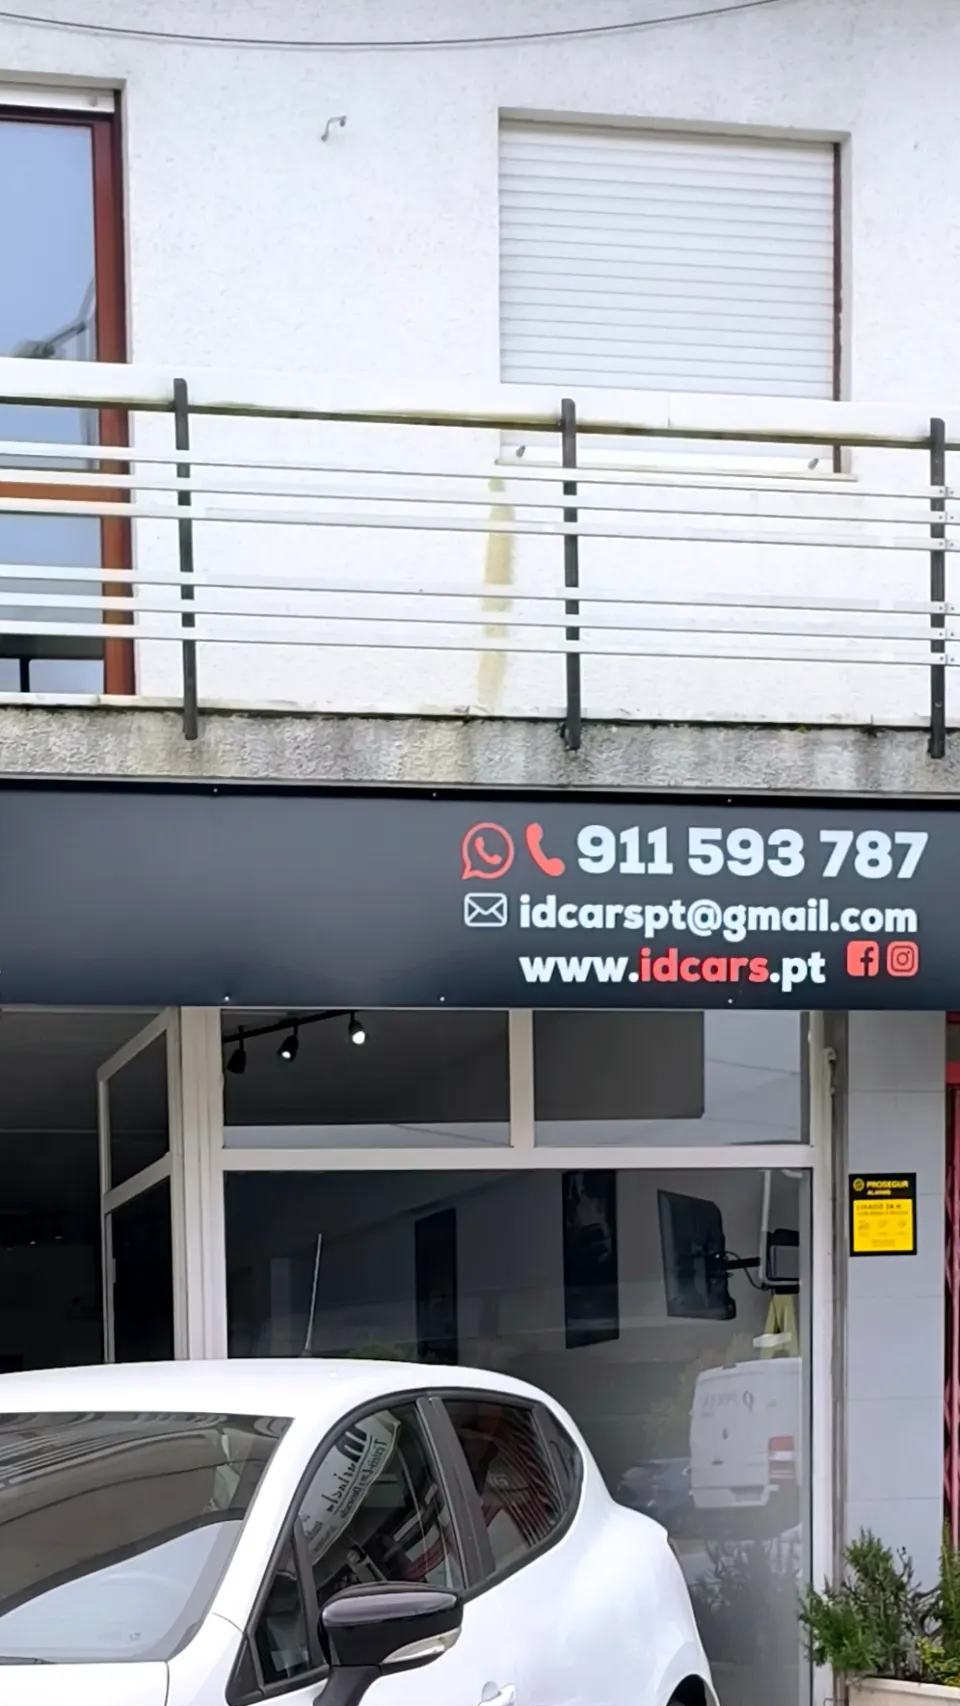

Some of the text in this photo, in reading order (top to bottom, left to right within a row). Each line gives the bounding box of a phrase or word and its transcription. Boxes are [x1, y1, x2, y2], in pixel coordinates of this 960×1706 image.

[576, 824, 928, 879] 911 593 787
[519, 894, 918, 943] idcarspt@gmail.com
[518, 947, 826, 992] www.idcars.pt
